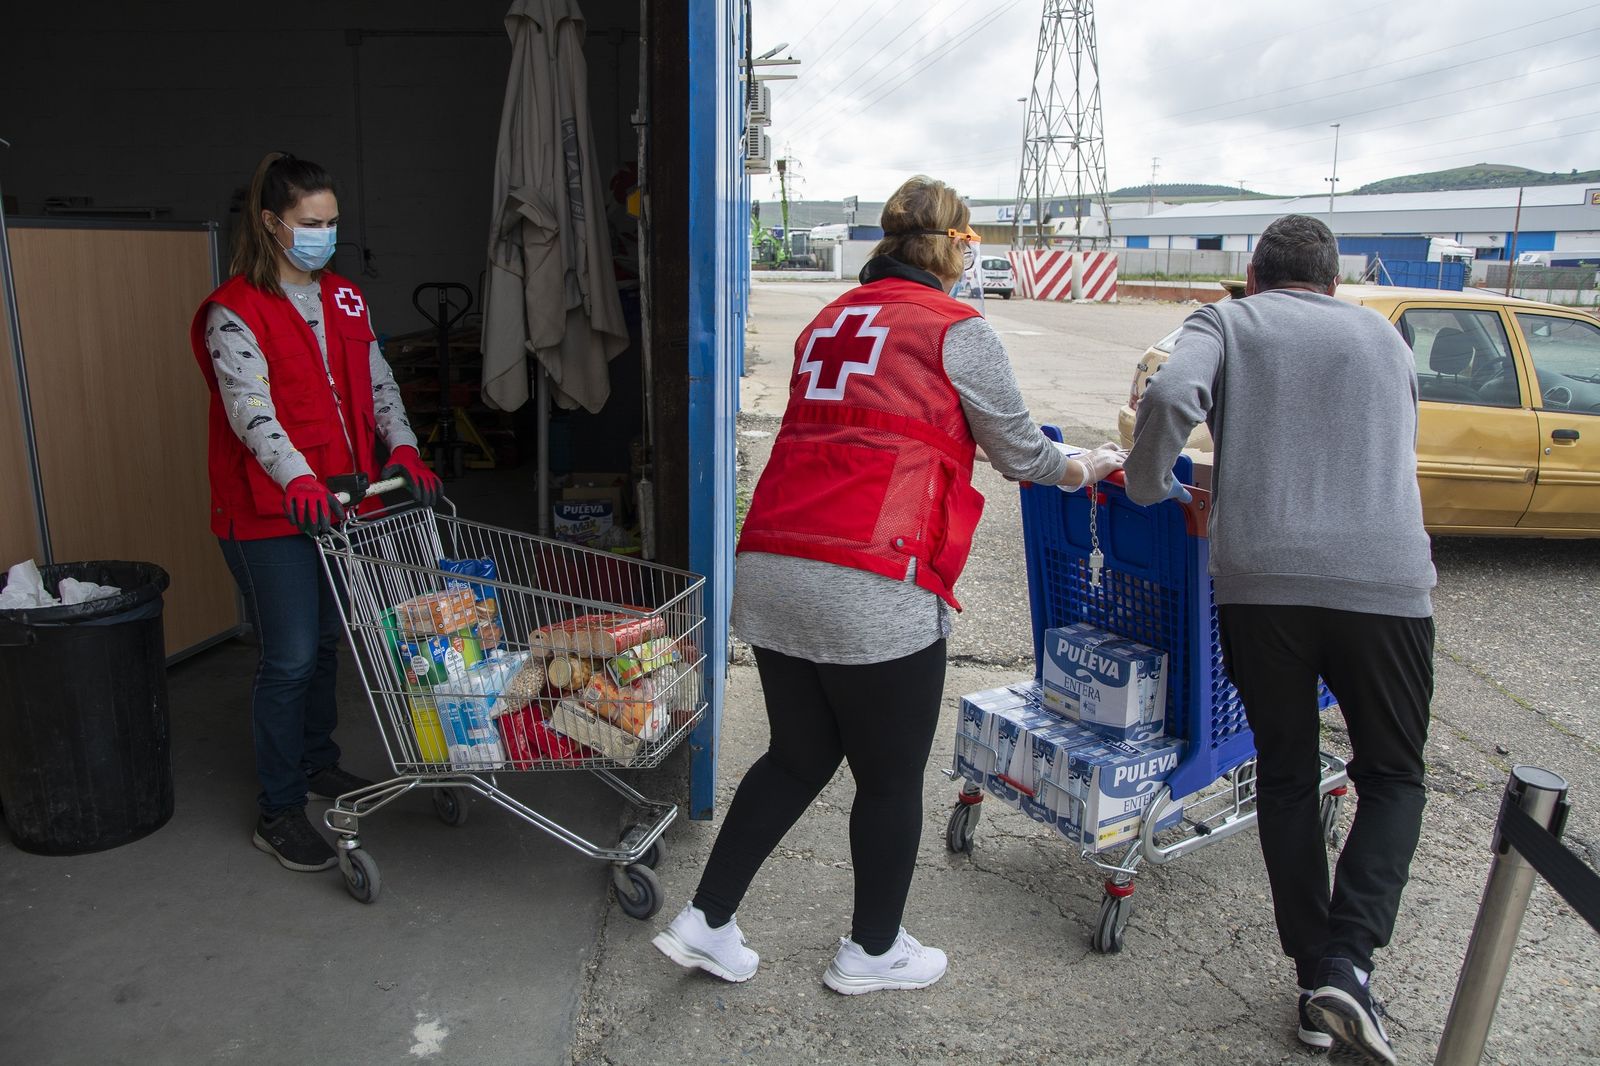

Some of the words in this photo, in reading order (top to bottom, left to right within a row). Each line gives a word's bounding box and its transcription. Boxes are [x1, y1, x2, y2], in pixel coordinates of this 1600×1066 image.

[563, 505, 604, 514] PULEVA
[1056, 638, 1120, 680] PULEVA
[1064, 677, 1101, 702] ENTERA
[1113, 751, 1178, 788] PULEVA
[1123, 791, 1156, 812] ENTER
